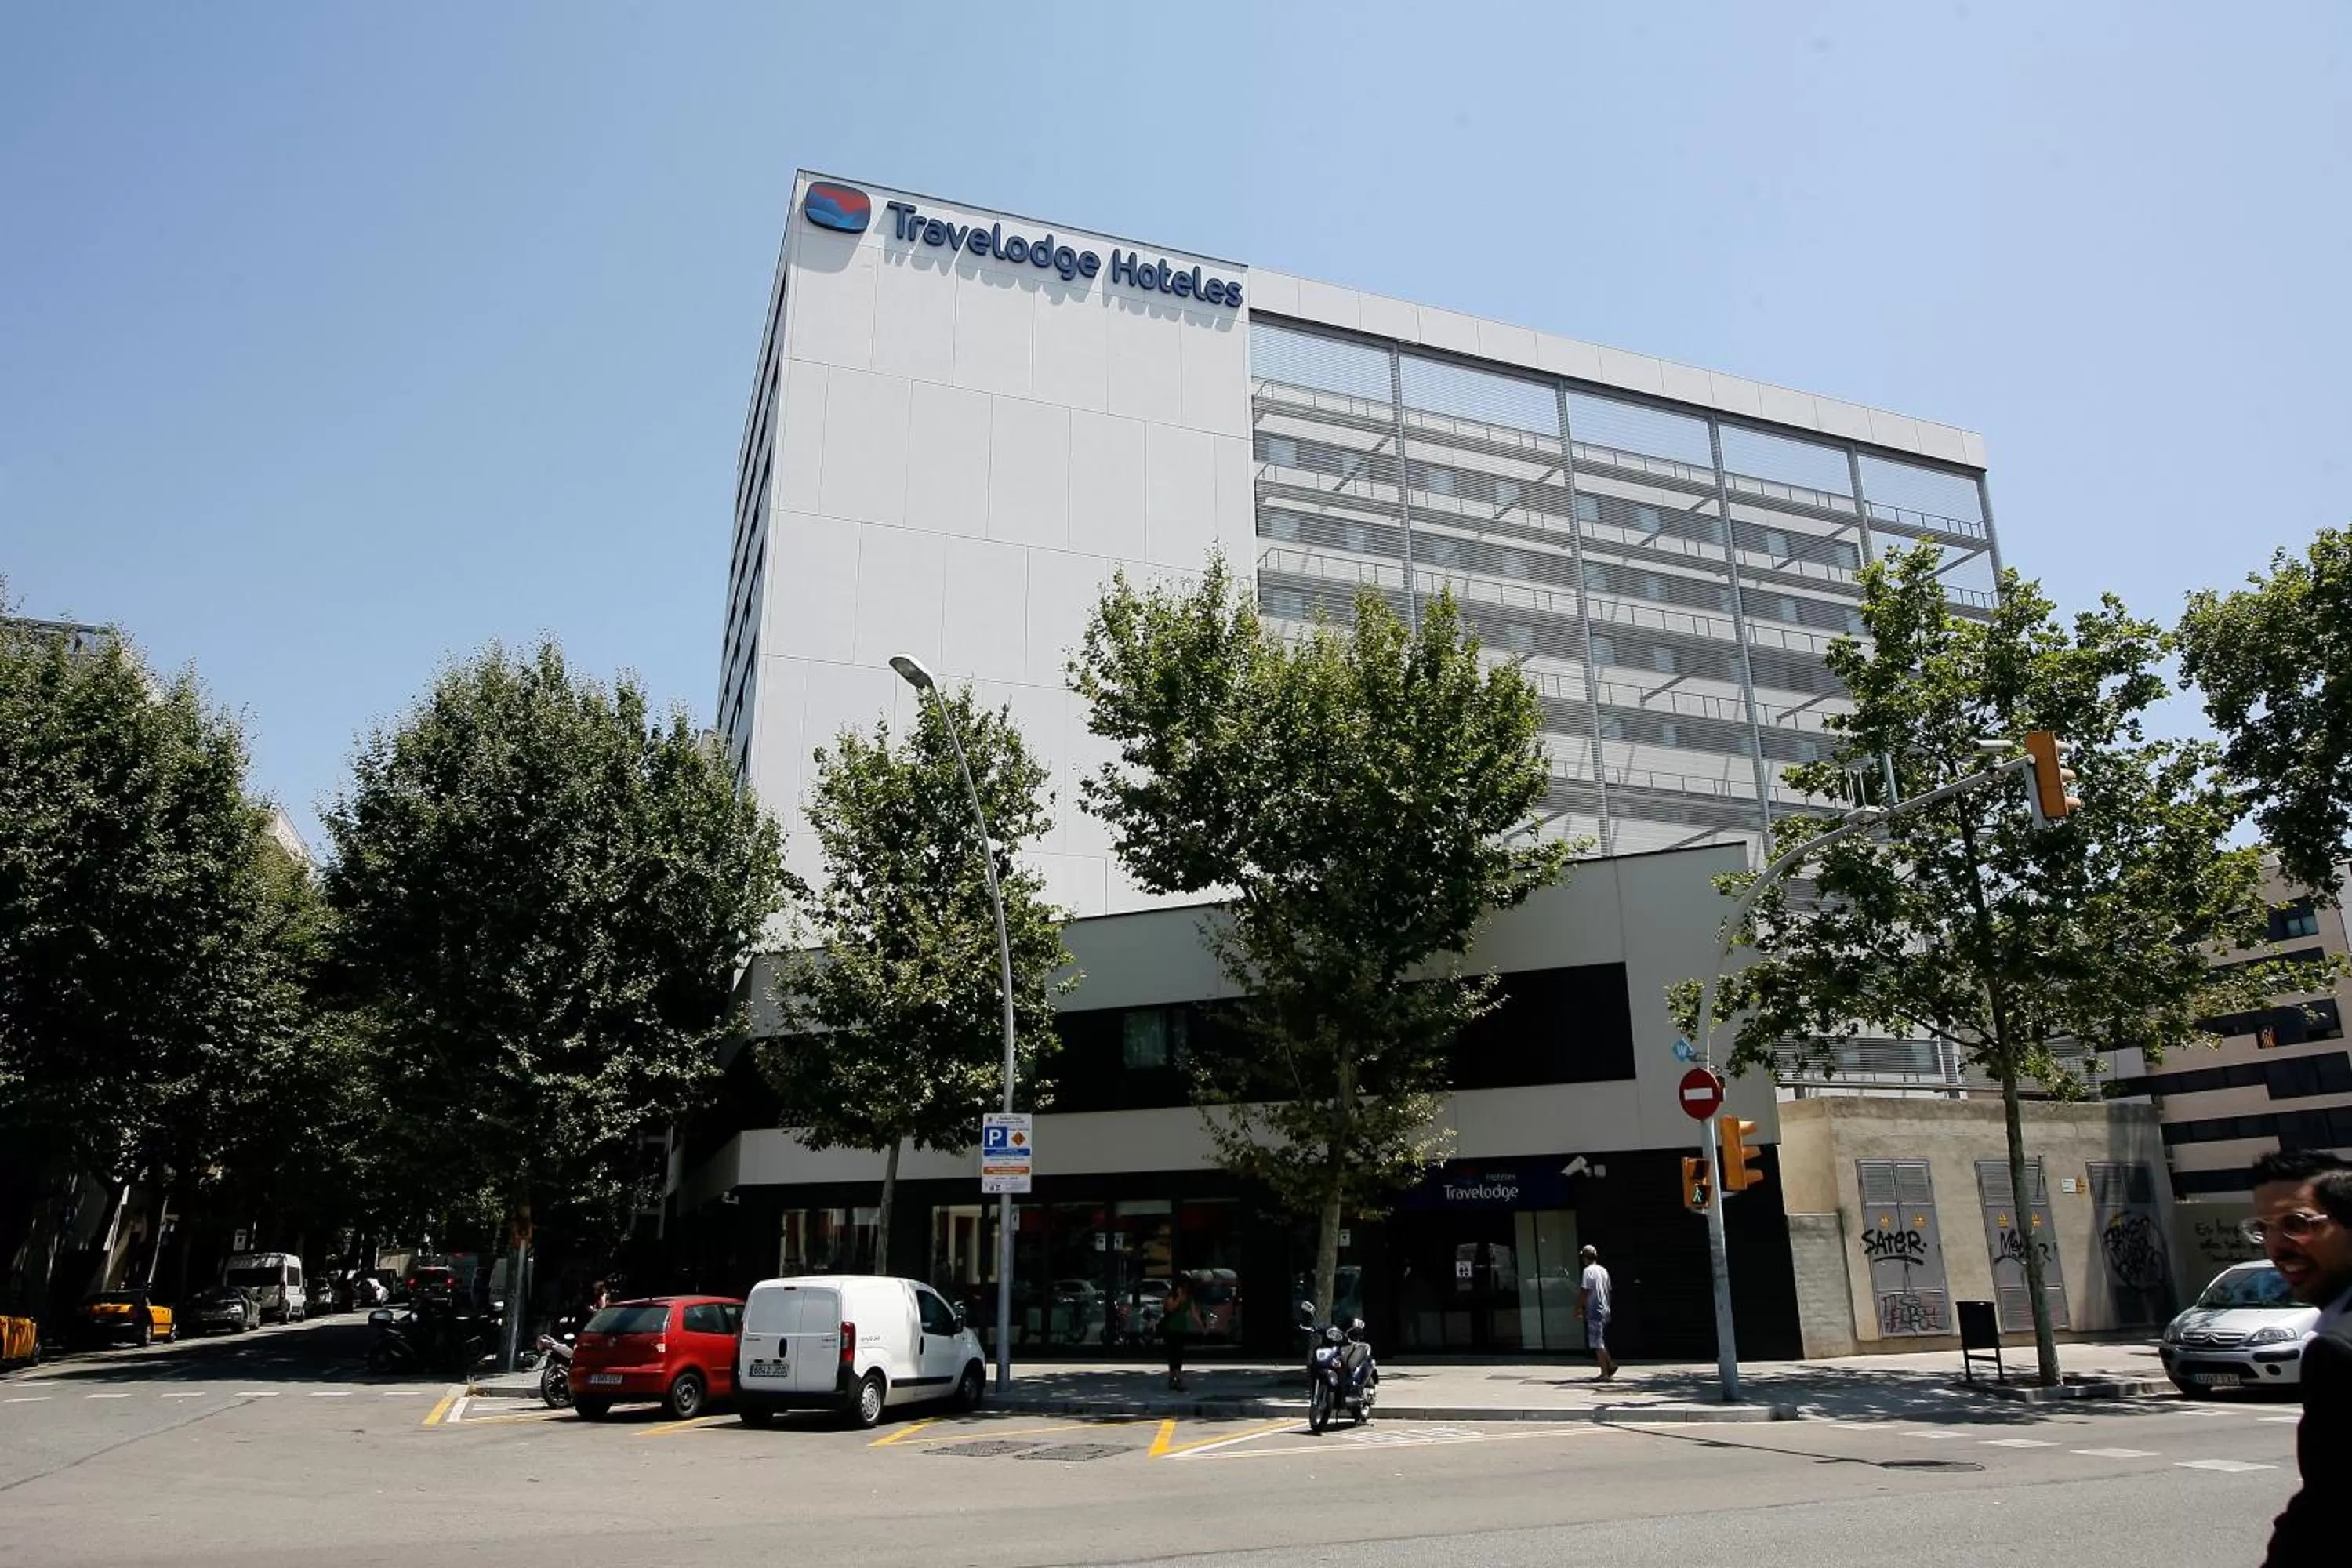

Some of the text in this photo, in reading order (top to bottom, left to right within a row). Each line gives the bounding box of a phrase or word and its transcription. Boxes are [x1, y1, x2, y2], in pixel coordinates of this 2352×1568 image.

[887, 201, 1243, 308] Travelodge Hoteles
[989, 1129, 1002, 1146] P
[1443, 1184, 1519, 1202] Travelodge
